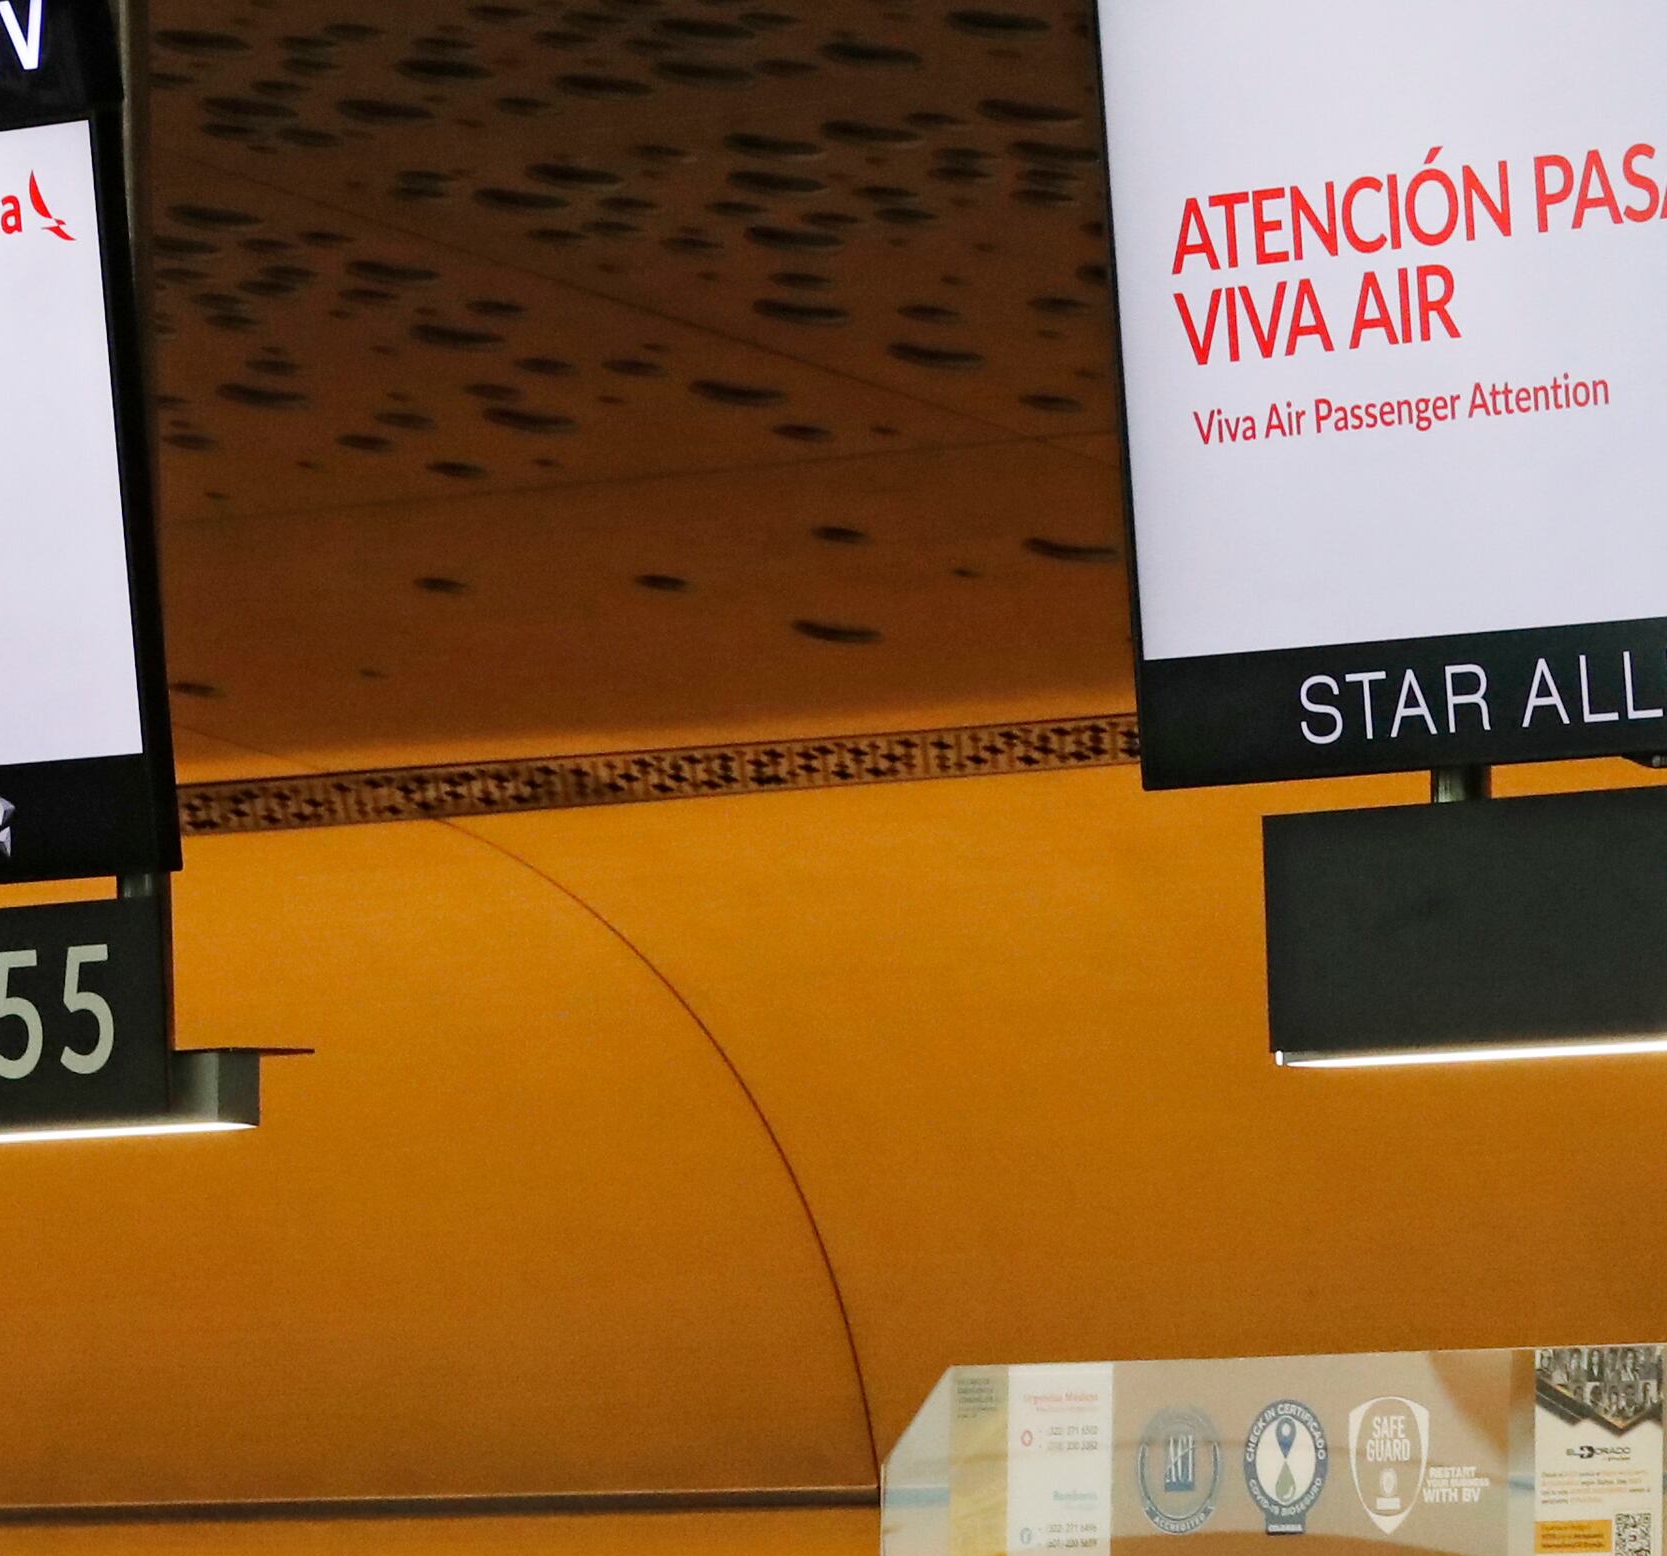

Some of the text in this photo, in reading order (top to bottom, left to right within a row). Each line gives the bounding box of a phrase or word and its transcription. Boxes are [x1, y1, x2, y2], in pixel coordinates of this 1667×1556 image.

[1173, 143, 1667, 276] ATENCIÓN PAS
[1173, 264, 1461, 366] VIVA AIR
[1194, 372, 1610, 446] Viva Air Passenger Attention
[1301, 664, 1490, 743] STAR
[1245, 1421, 1266, 1463] CHECK
[1277, 1402, 1327, 1461] CERTIFICADO
[1366, 1438, 1411, 1463] GUARD
[1372, 1415, 1406, 1439] SAFE
[1422, 1487, 1483, 1503] WITH BV
